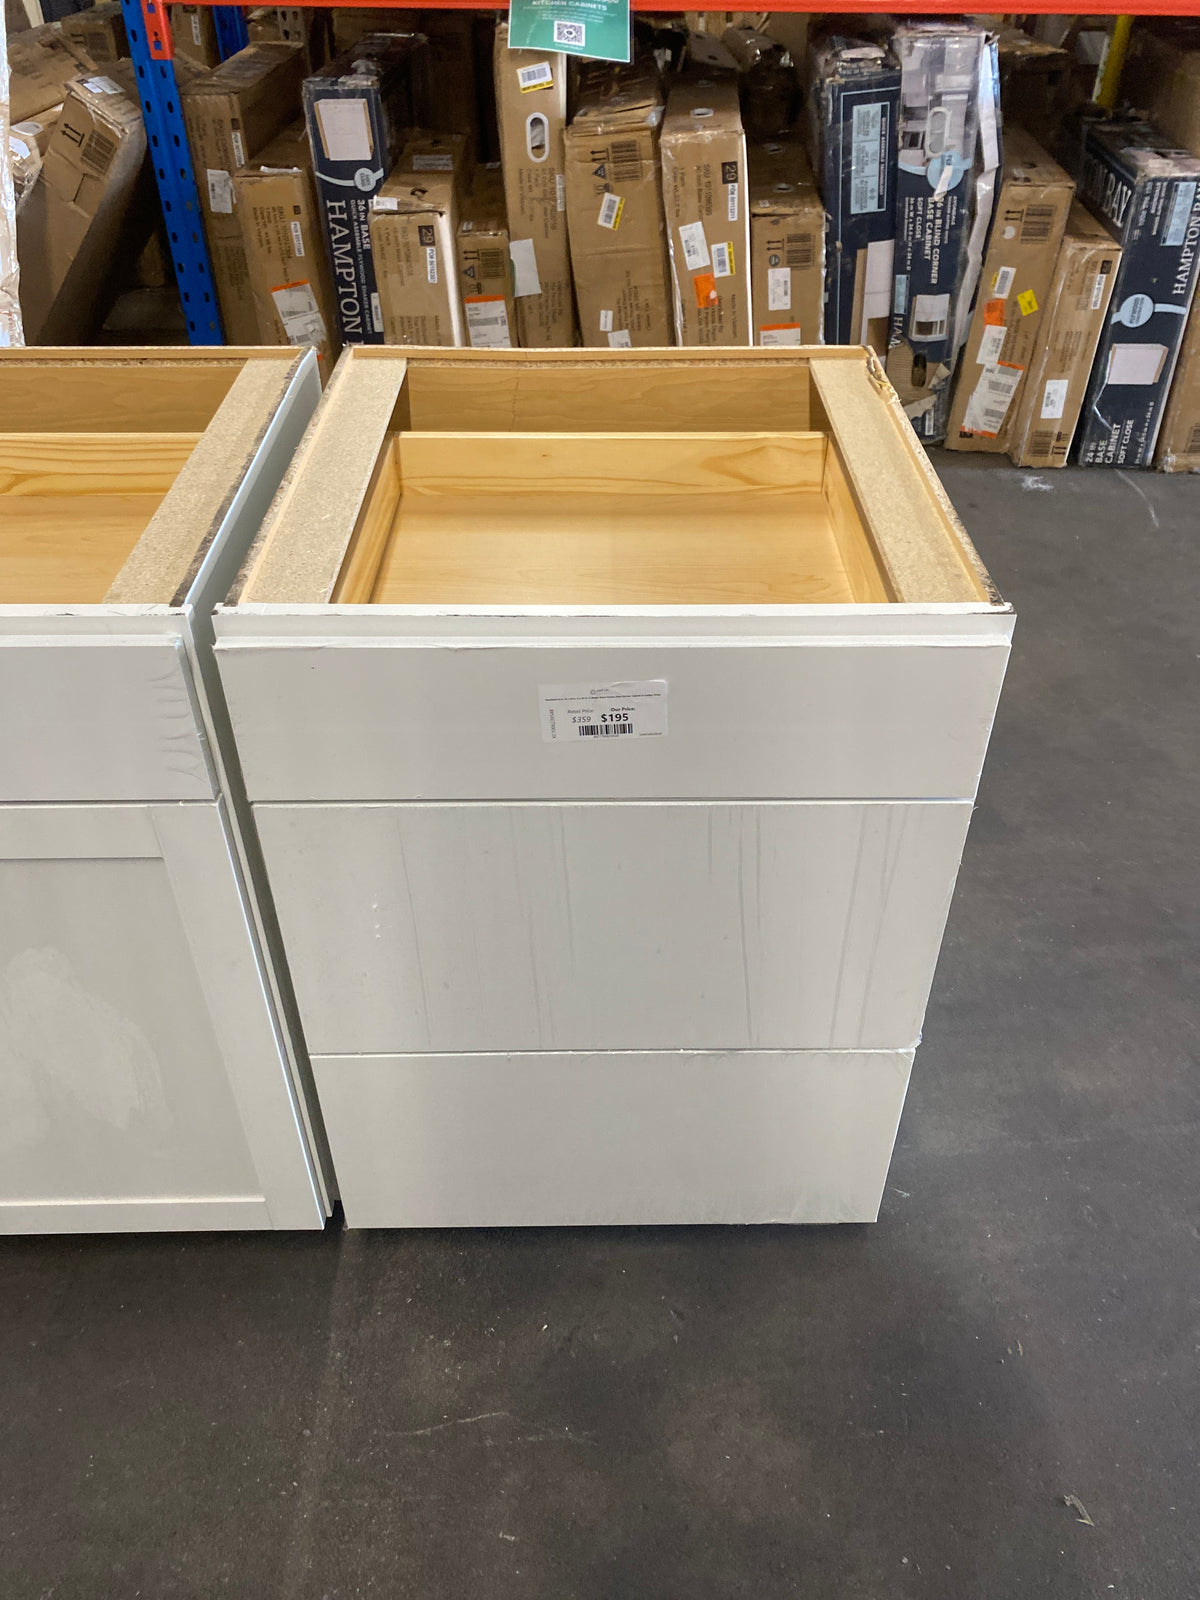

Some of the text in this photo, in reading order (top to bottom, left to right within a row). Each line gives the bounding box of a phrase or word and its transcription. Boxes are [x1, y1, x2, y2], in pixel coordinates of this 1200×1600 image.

[568, 1, 608, 11] CABINETS
[357, 200, 371, 250] 36 IN BASE
[924, 197, 935, 260] BASE CABINET
[933, 219, 943, 246] BLIND
[326, 200, 363, 335] HAMPTON
[350, 200, 373, 334] QUICK ASSEMBLE PLYWOOD SHAKER CABINET
[930, 248, 940, 284] CORNER
[1172, 216, 1200, 294] HAMPTON
[1085, 452, 1094, 463] 24
[1095, 439, 1107, 464] BASE
[1105, 423, 1121, 464] CABINET
[1117, 419, 1135, 464] SOFT CLOSE
[572, 716, 592, 724] $359
[600, 713, 629, 723] $195
